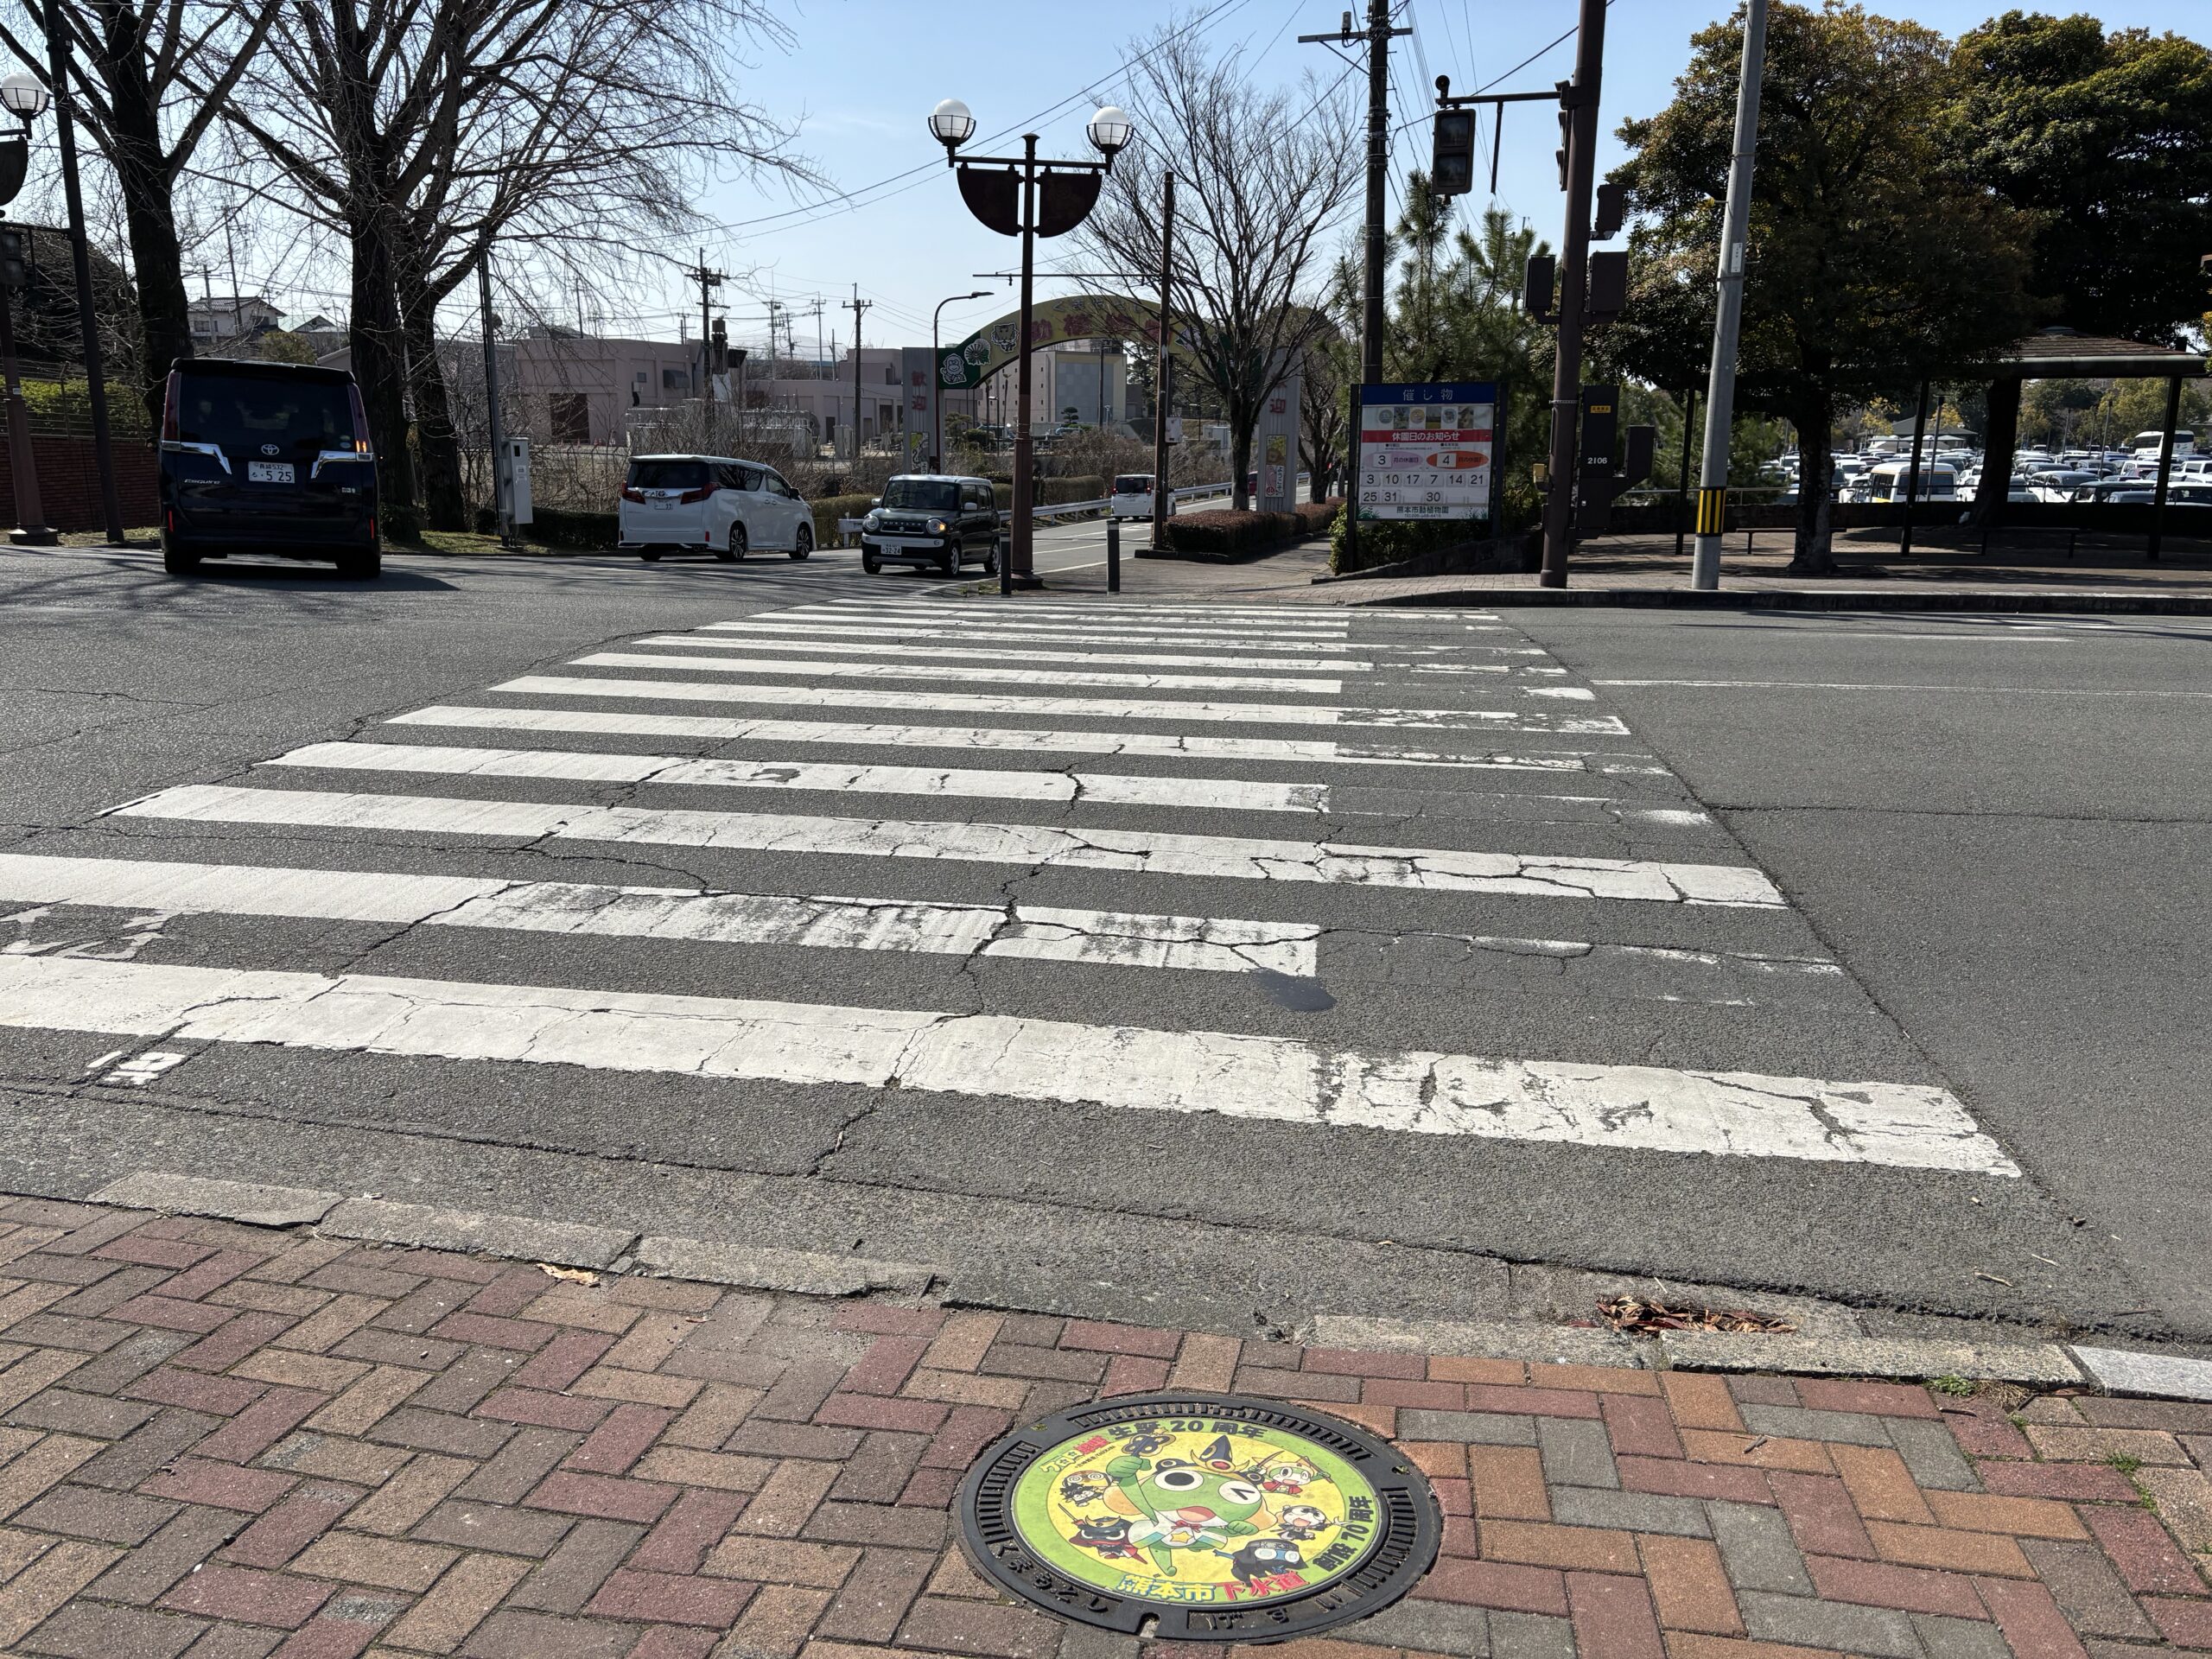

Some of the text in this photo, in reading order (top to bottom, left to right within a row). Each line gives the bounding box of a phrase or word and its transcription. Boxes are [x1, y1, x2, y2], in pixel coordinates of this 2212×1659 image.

[1403, 389, 1453, 401] 催し物
[1392, 432, 1460, 442] 休園日のお知らせ
[1377, 454, 1386, 466] 3
[1442, 454, 1450, 466] 4
[1367, 474, 1484, 485] 3 10 17 7 14 21
[1363, 492, 1440, 502] 25 31 30
